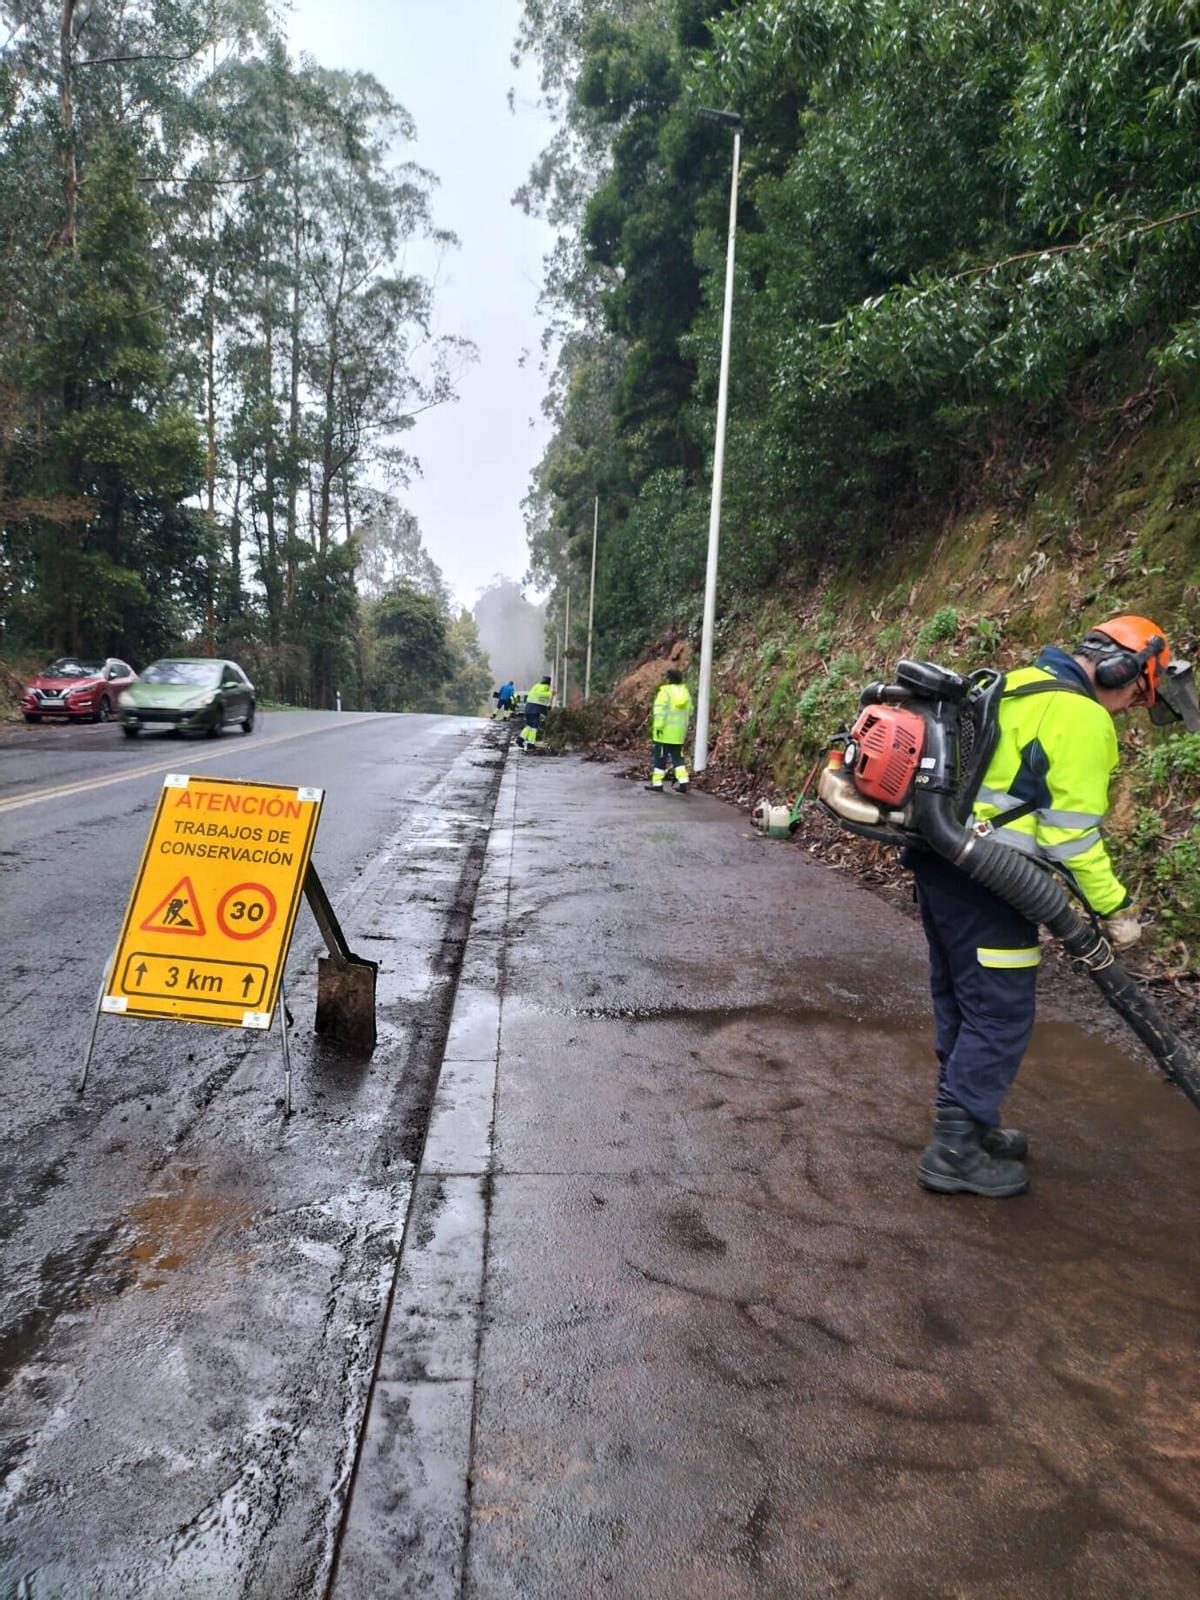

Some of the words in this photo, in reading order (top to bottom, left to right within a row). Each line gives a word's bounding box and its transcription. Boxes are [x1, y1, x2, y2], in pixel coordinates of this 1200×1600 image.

[175, 790, 303, 819] ATENCIÓN
[174, 820, 264, 841] TRABAJOS
[267, 830, 291, 844] DE
[160, 841, 294, 866] CONSERVACIÓN
[230, 901, 264, 922] 30
[165, 966, 178, 988] 3
[186, 971, 223, 993] km
